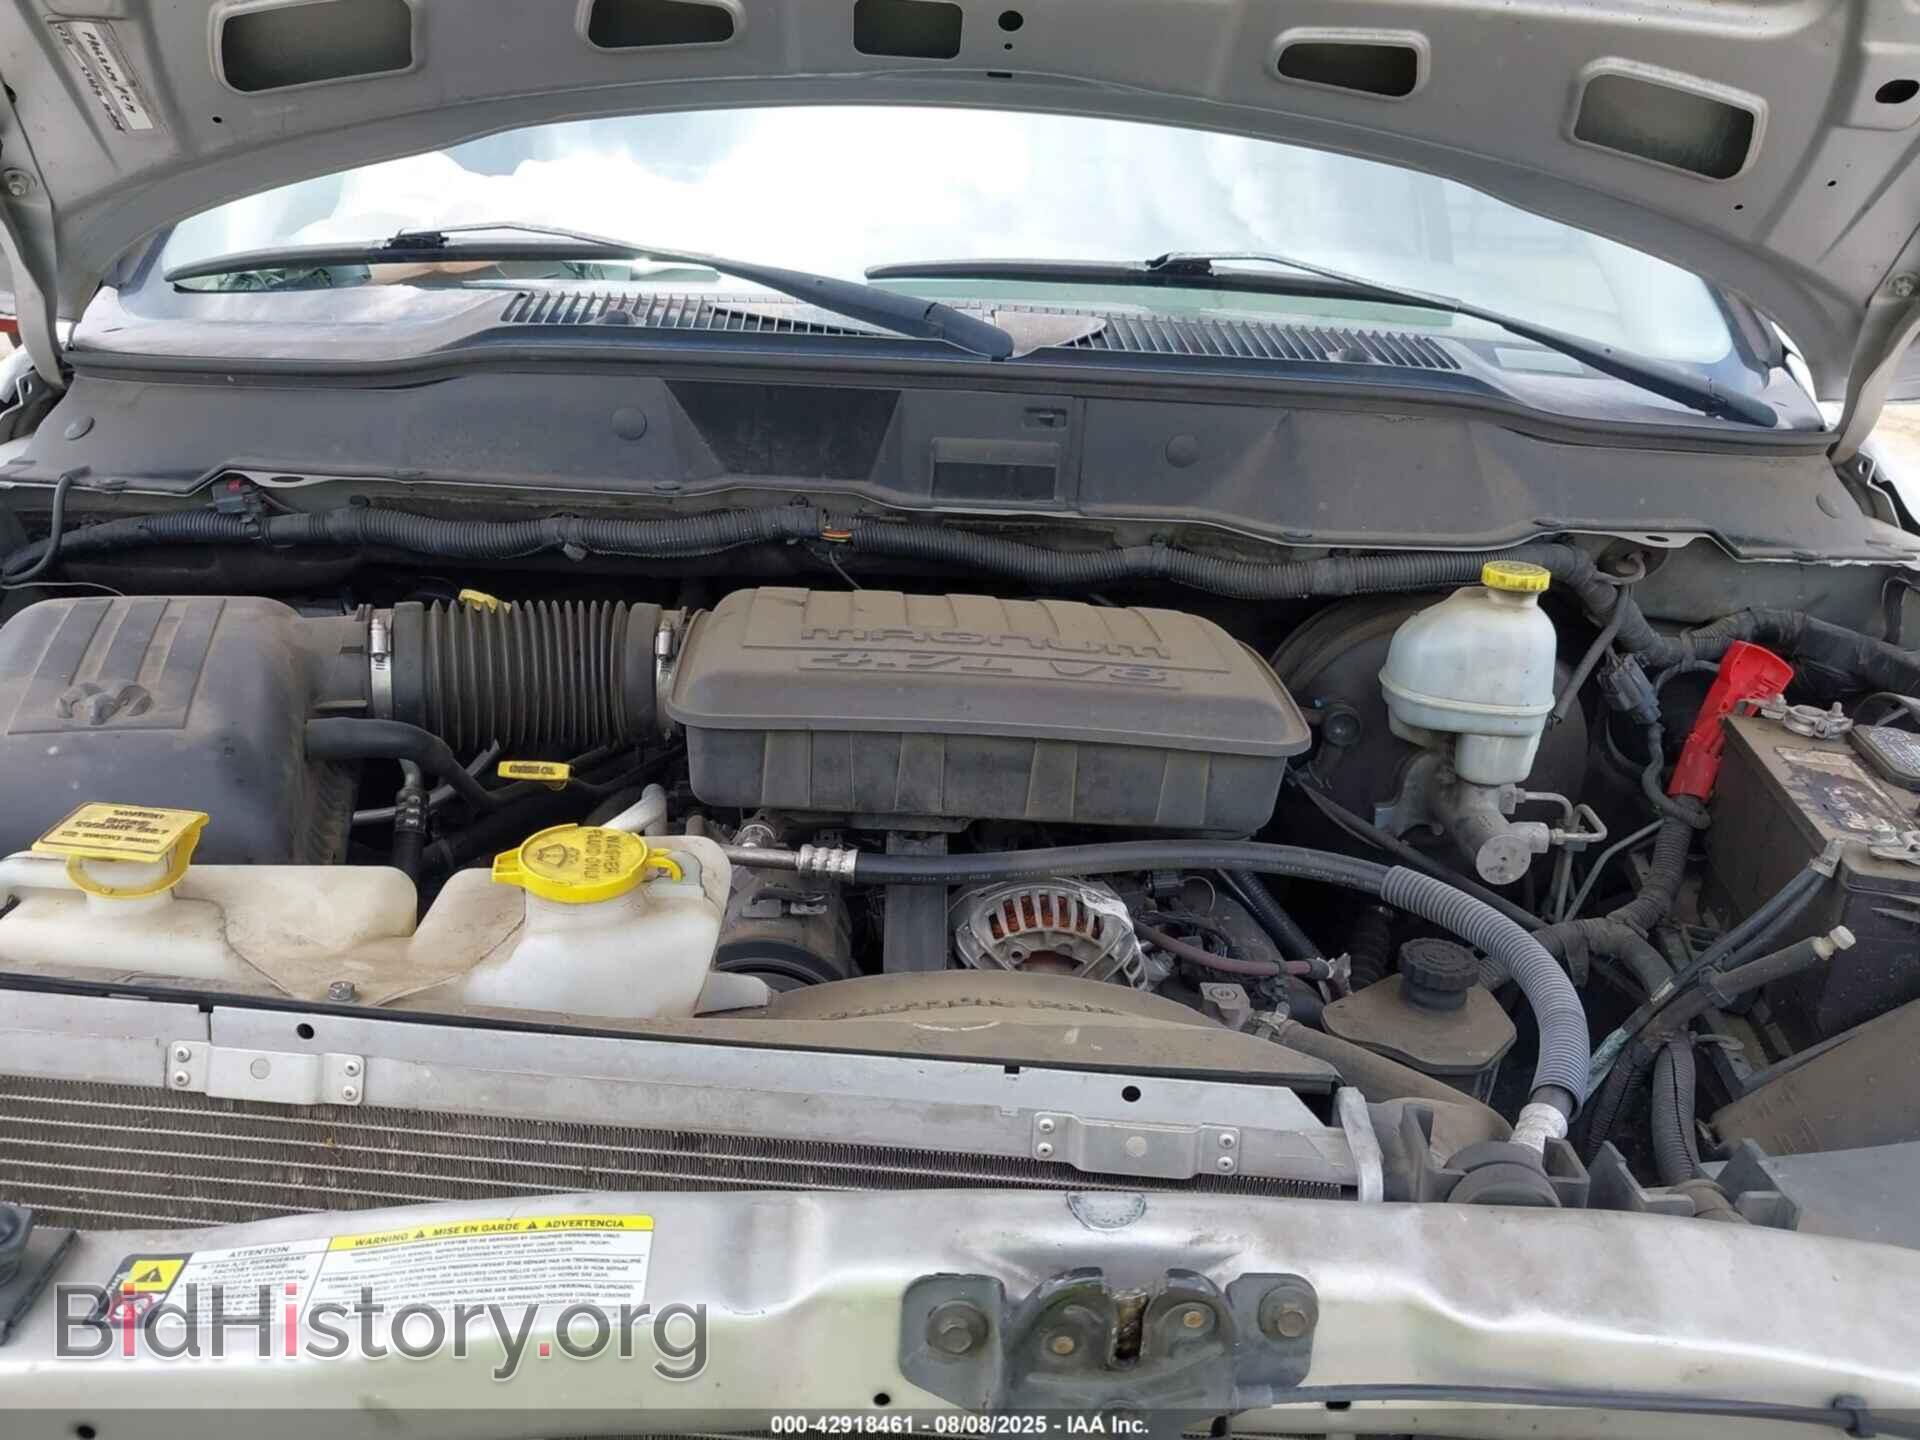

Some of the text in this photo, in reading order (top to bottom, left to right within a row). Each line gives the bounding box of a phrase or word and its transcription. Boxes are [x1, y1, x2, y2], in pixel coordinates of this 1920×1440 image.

[800, 626, 1172, 660] MAGNUM
[811, 652, 1169, 682] 4.7L V8
[355, 1233, 409, 1247] WARNING
[432, 1225, 460, 1236] MISE
[463, 1224, 479, 1233] EN
[481, 1222, 520, 1233] GARDE
[545, 1219, 625, 1229] ADVERTENCIA
[229, 1246, 290, 1258] ATTENTION
